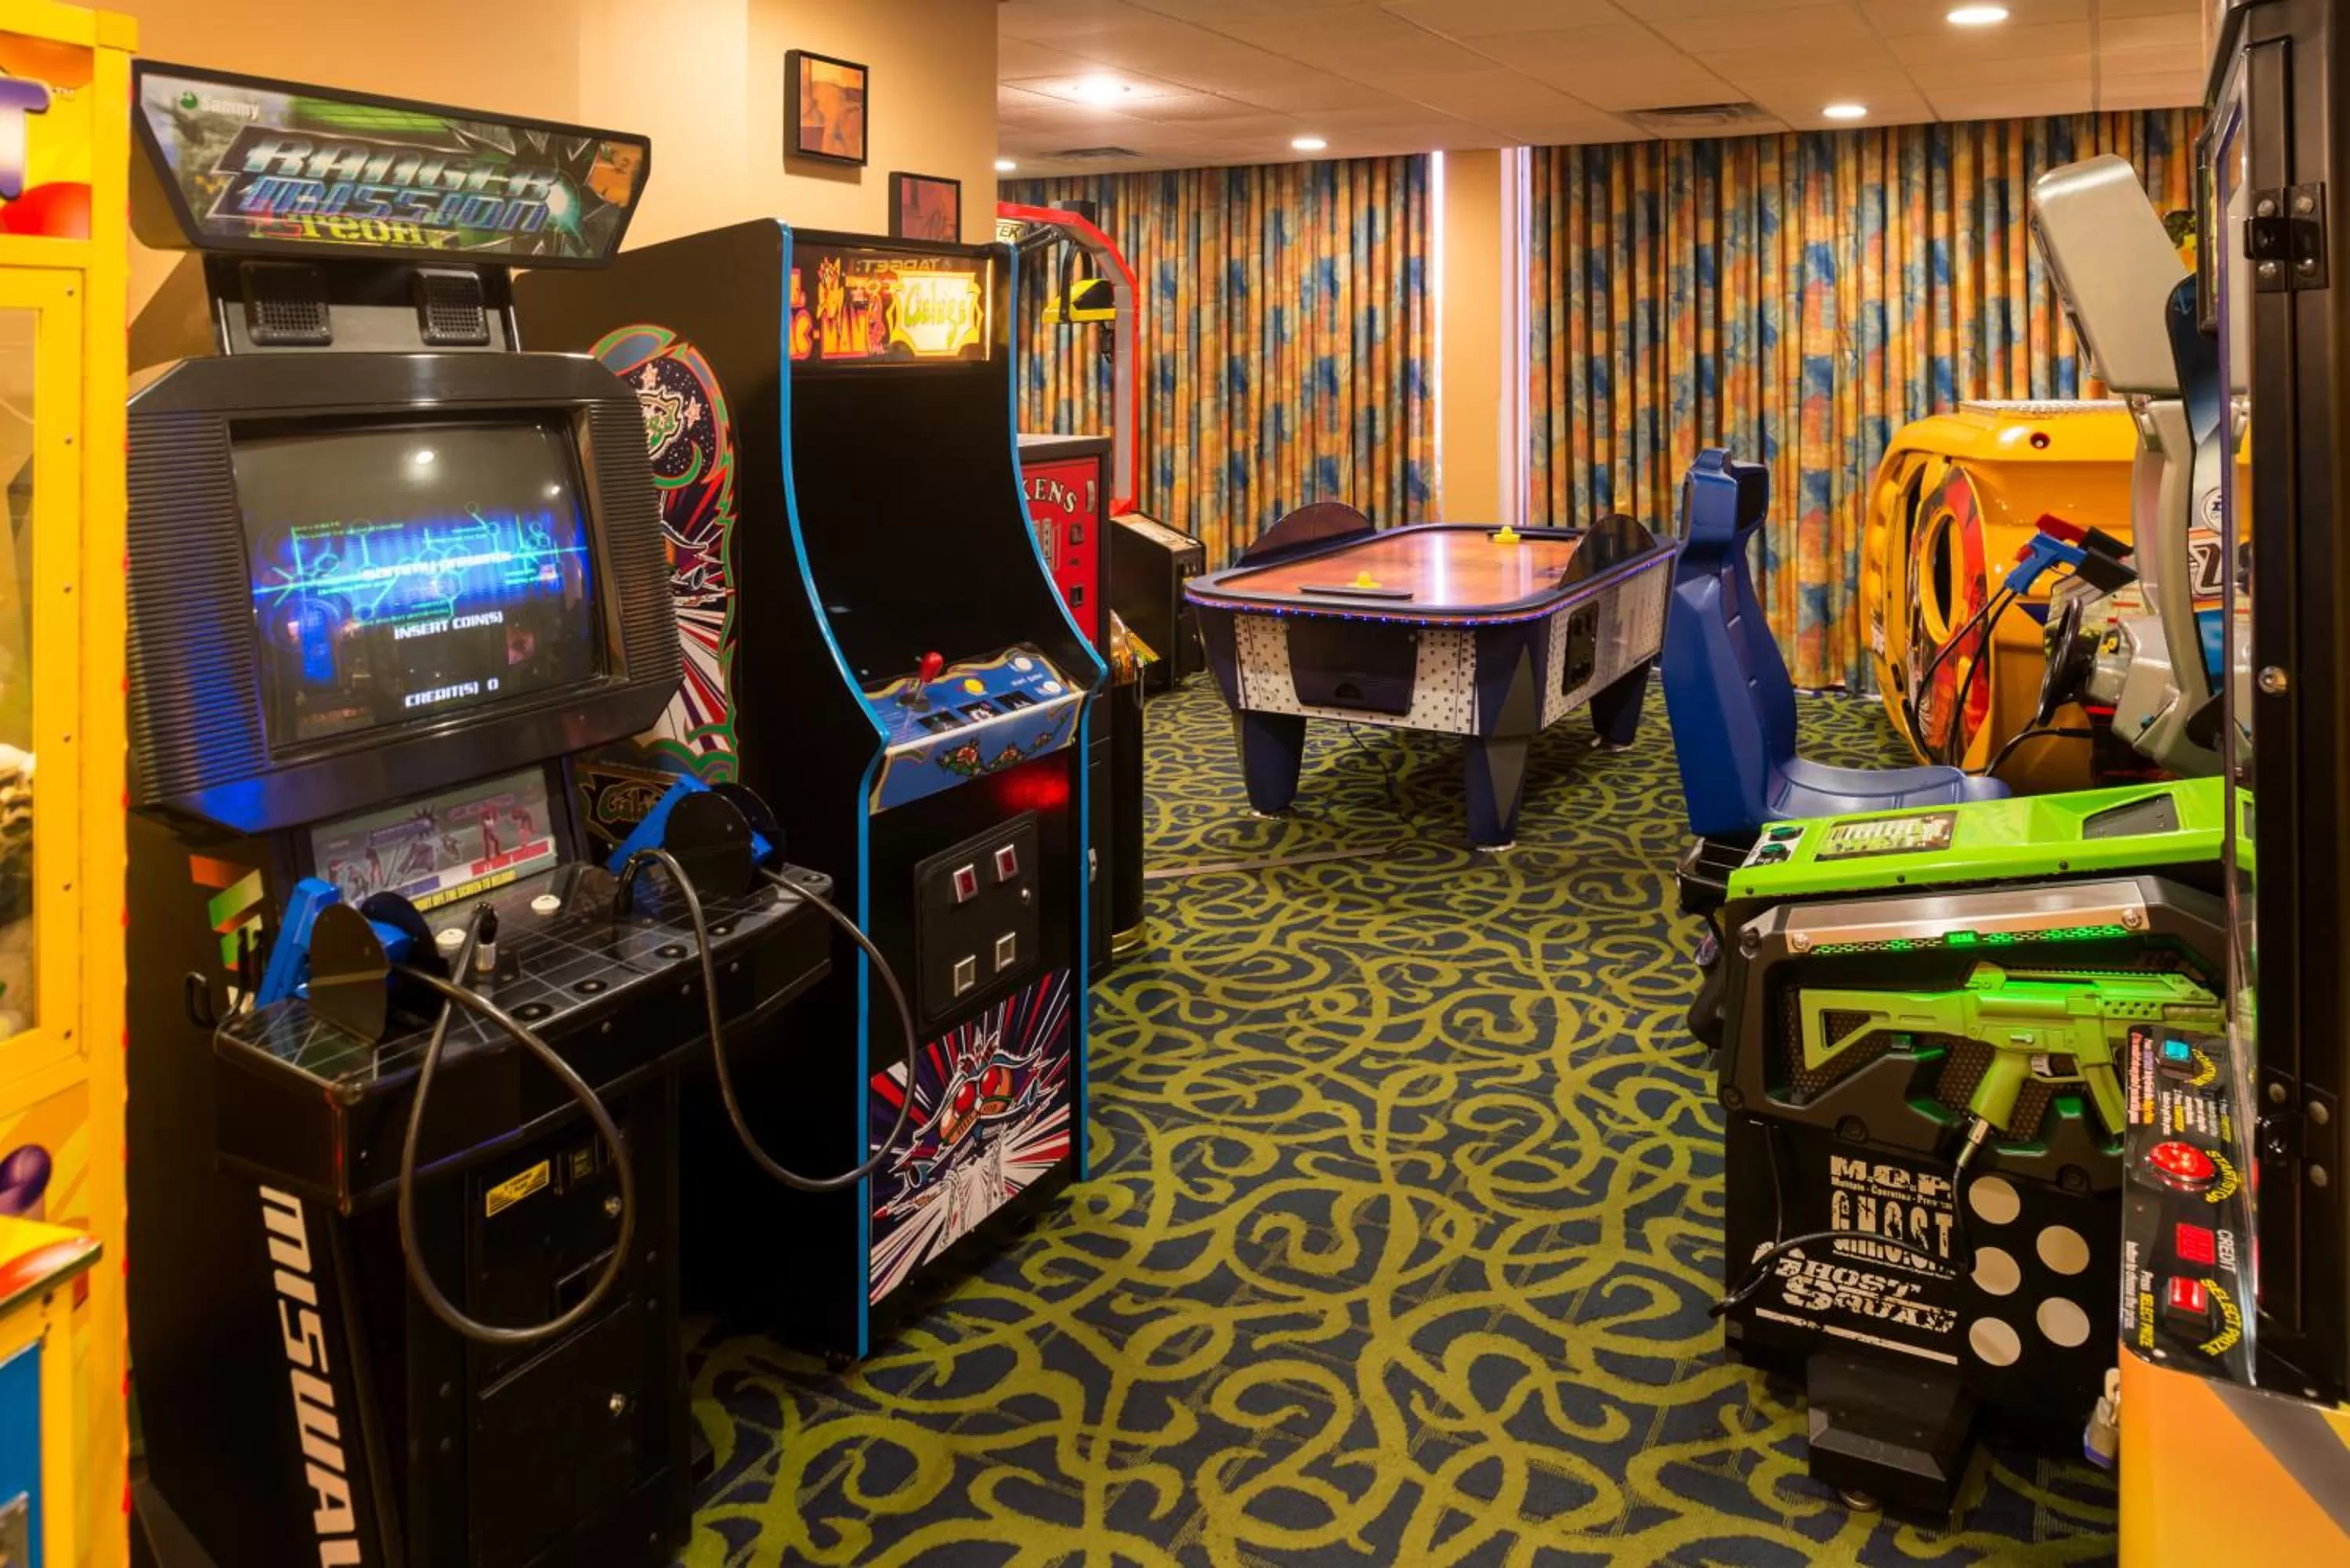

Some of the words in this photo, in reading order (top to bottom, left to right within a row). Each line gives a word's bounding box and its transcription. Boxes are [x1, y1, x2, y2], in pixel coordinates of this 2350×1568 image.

[996, 223, 1021, 239] EK
[393, 620, 449, 640] INSERT
[451, 610, 504, 630] COIN(S)
[404, 680, 479, 708] CREDIT(S)
[486, 676, 499, 692] 0
[2216, 1229, 2236, 1274] CREDIT
[2200, 1277, 2242, 1329] SELECT
[2198, 1326, 2242, 1357] PRIZE
